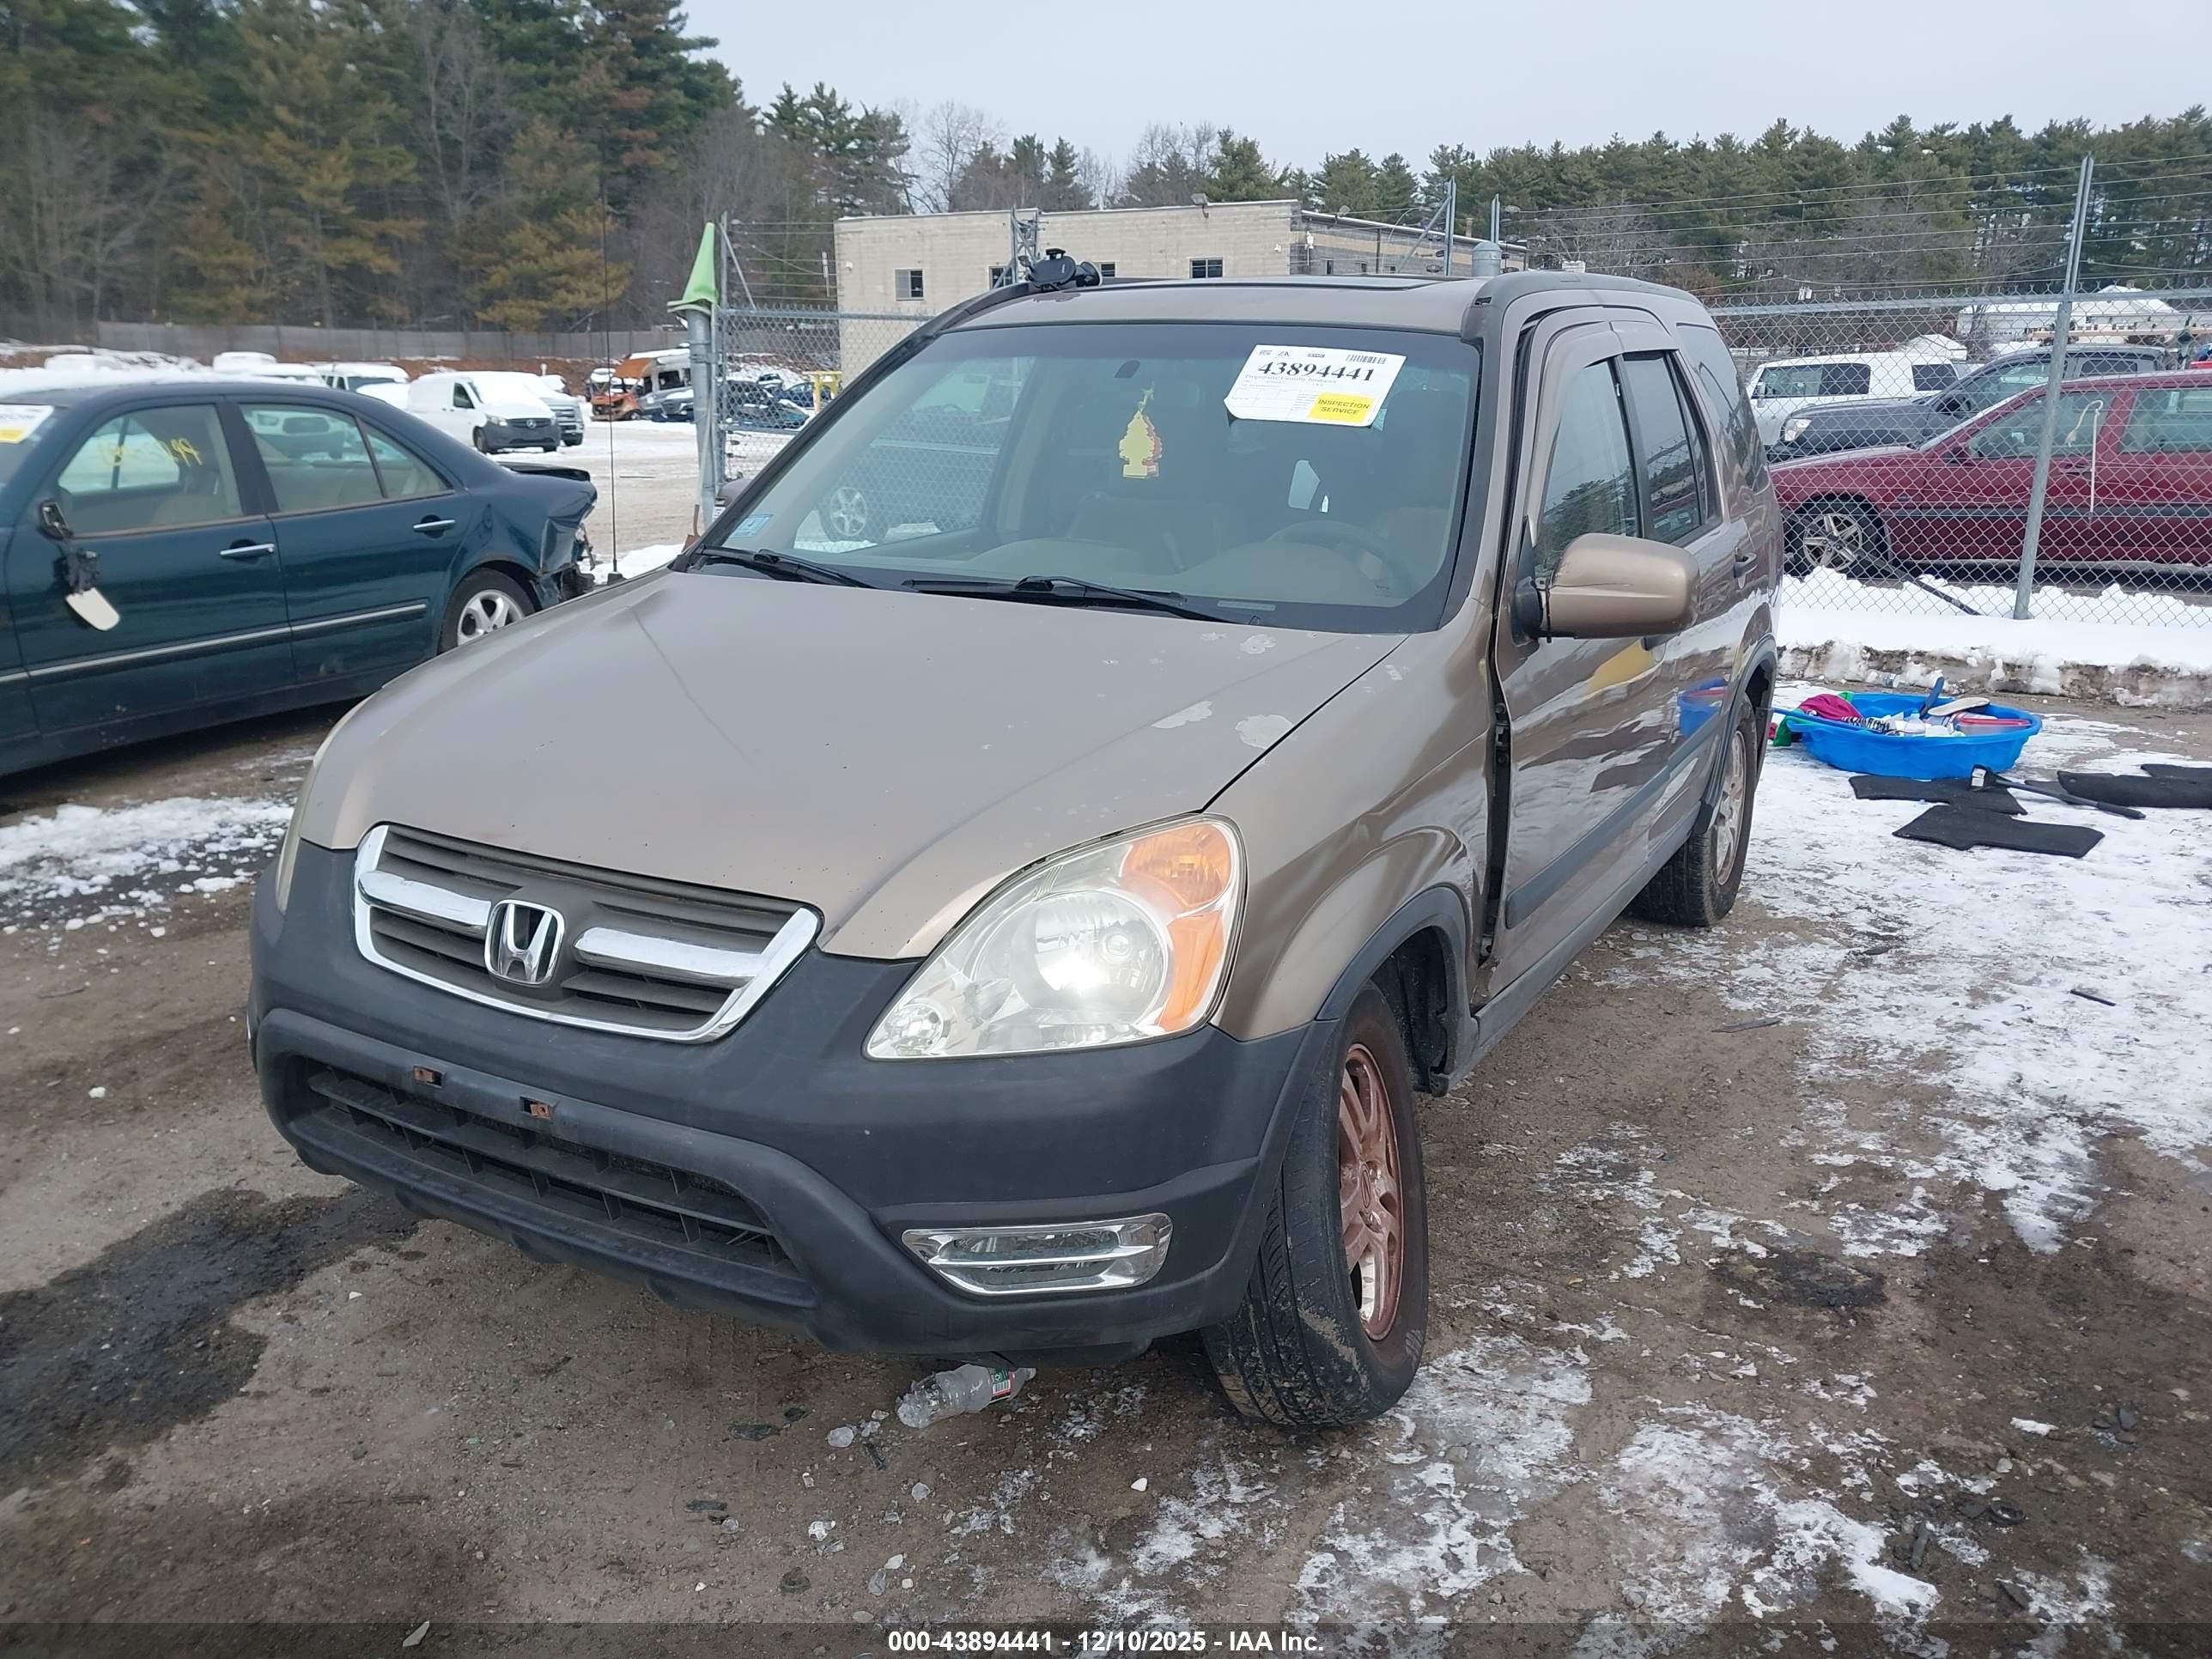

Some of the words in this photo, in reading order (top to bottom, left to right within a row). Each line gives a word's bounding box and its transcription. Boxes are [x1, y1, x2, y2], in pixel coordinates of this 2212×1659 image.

[1258, 362, 1375, 381] 43894441
[1317, 398, 1370, 410] INSPECTION
[1320, 406, 1360, 415] SERVICE
